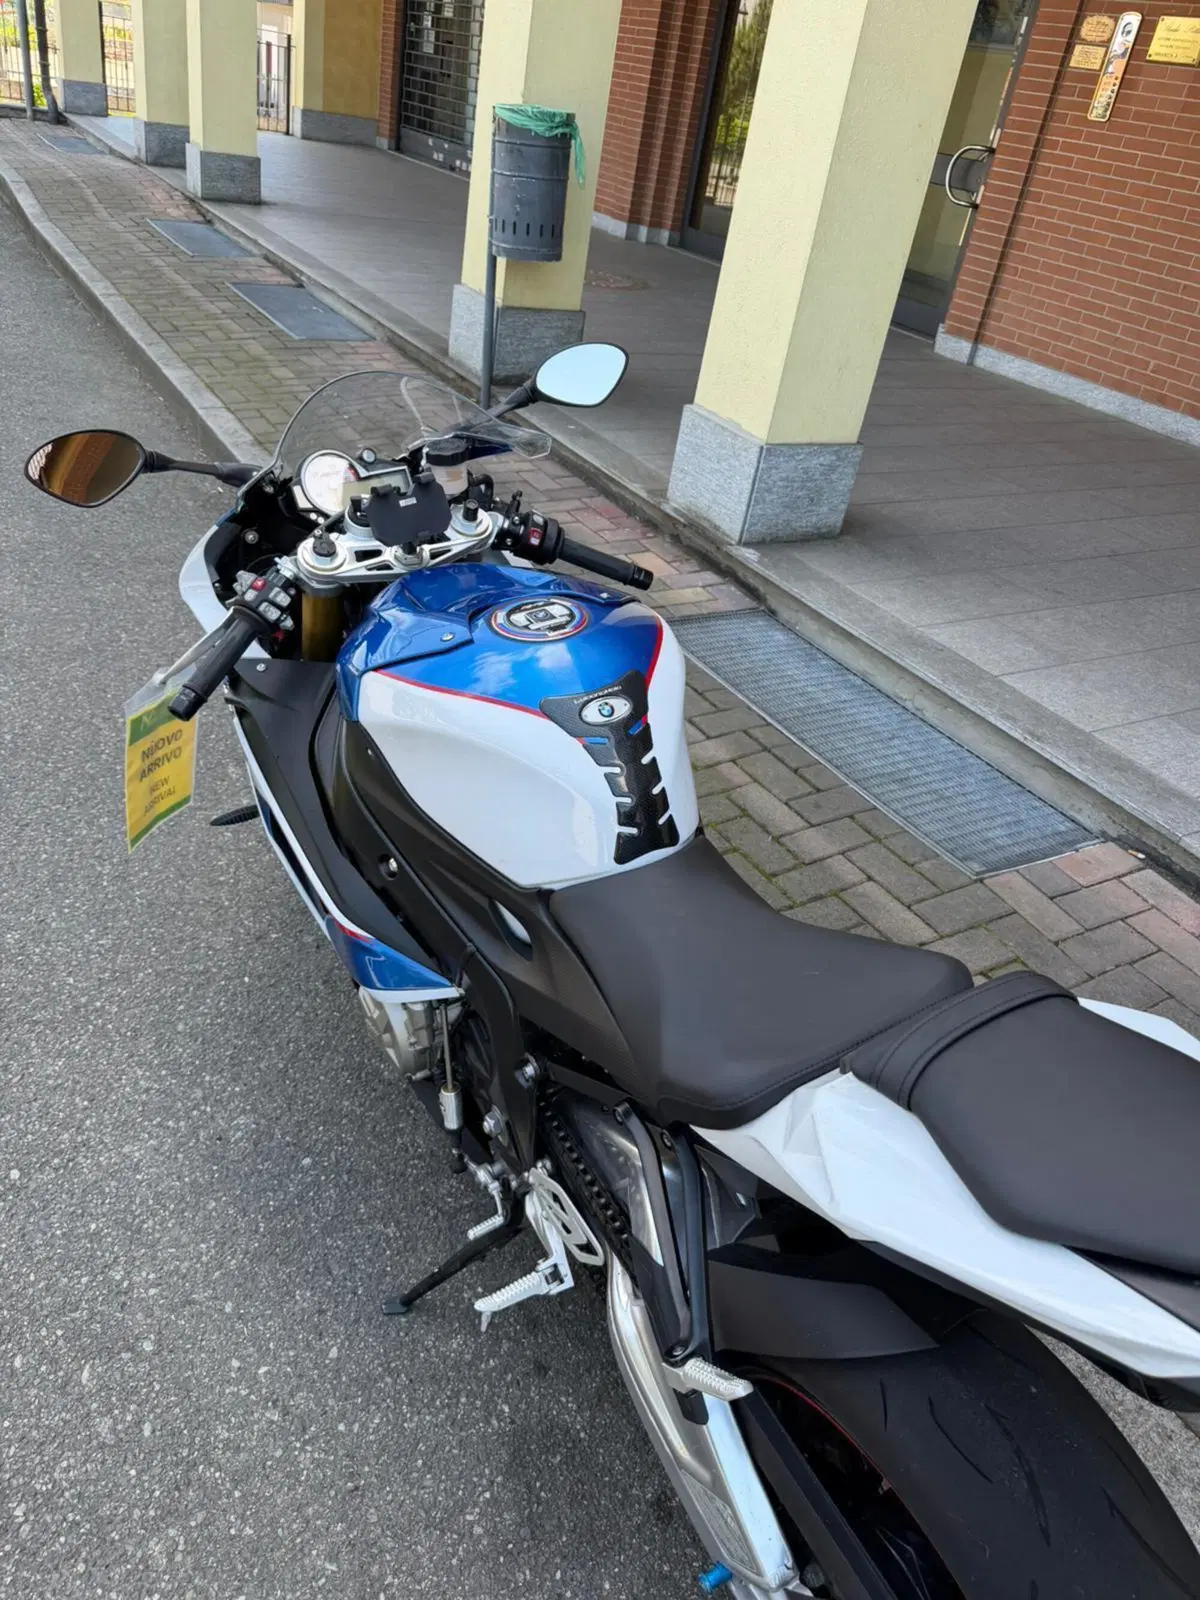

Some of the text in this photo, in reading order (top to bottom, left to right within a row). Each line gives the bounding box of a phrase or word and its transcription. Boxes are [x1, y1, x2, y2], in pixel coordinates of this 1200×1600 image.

[140, 729, 183, 762] NUOVO
[139, 746, 182, 783] ARRIVO
[144, 786, 177, 817] ARRIVAL
[149, 776, 170, 796] NEW
